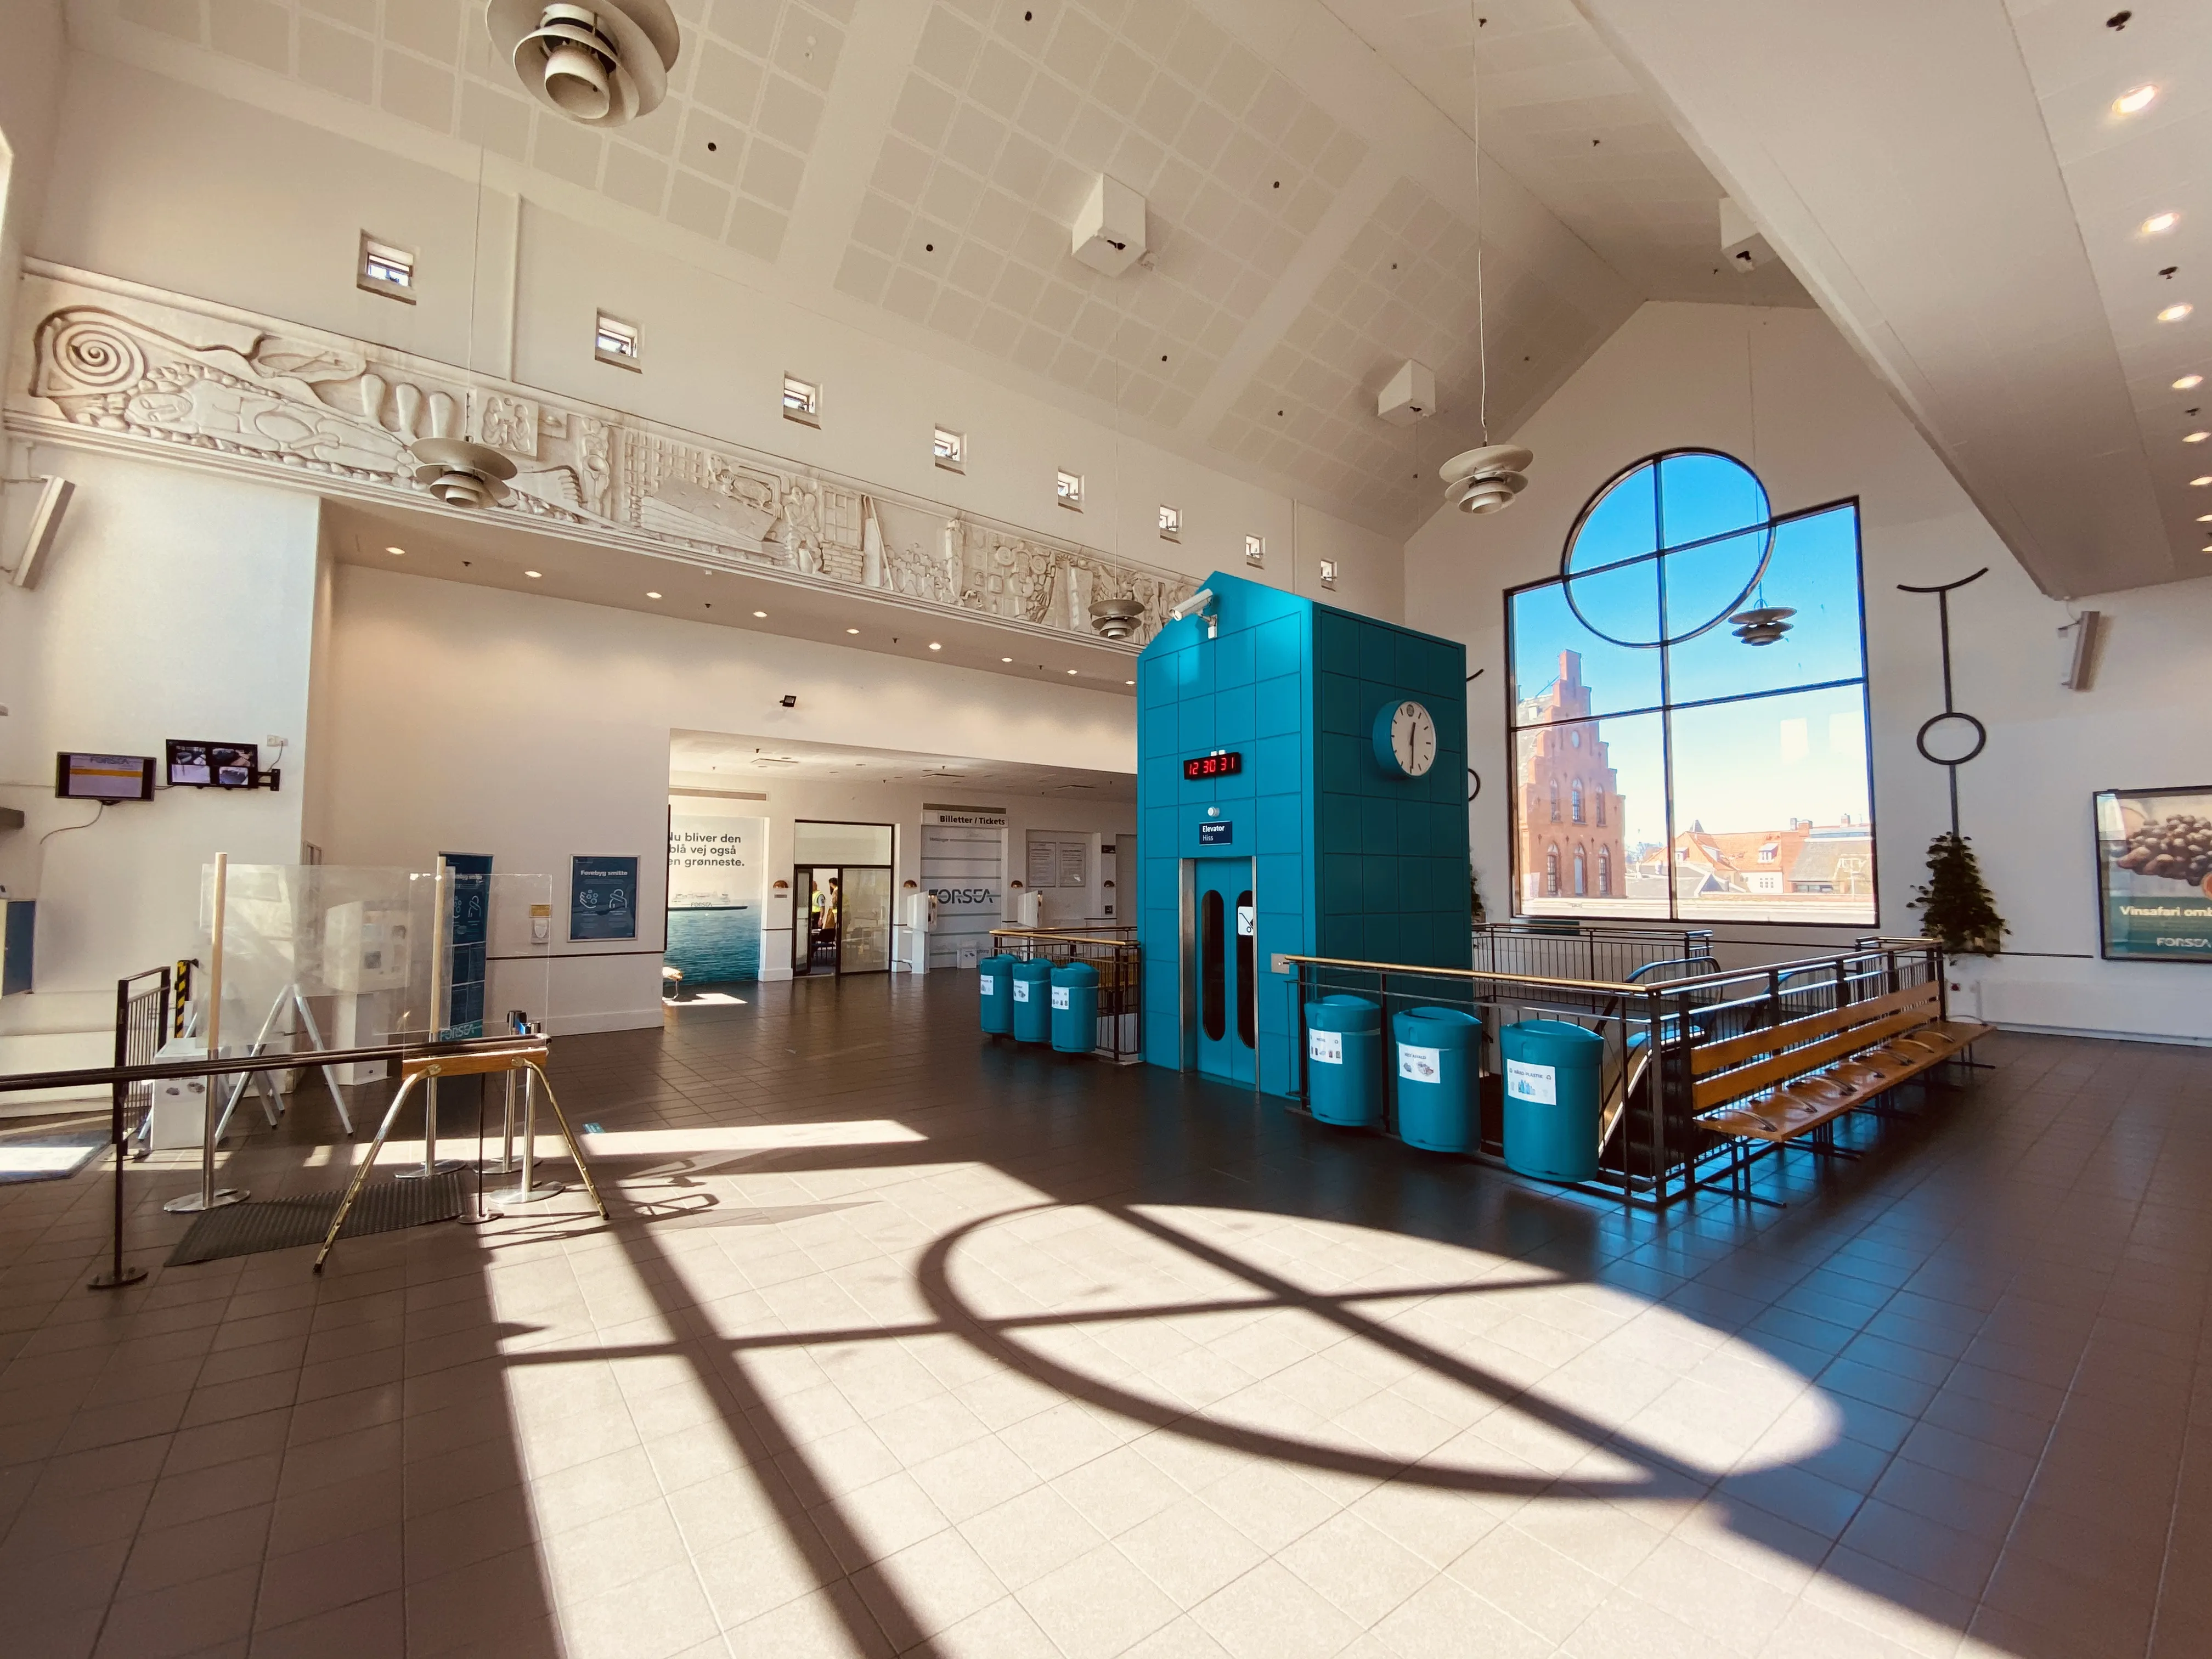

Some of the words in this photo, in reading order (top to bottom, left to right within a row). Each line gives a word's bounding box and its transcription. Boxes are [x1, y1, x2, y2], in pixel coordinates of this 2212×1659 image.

[940, 815, 972, 823] Billetter
[685, 832, 717, 842] bliver
[720, 834, 741, 843] den
[690, 845, 707, 856] vej
[710, 845, 736, 856] også
[684, 858, 744, 867] grønneste.
[2119, 906, 2181, 916] Vinsafari
[2157, 937, 2211, 949] FORSEA
